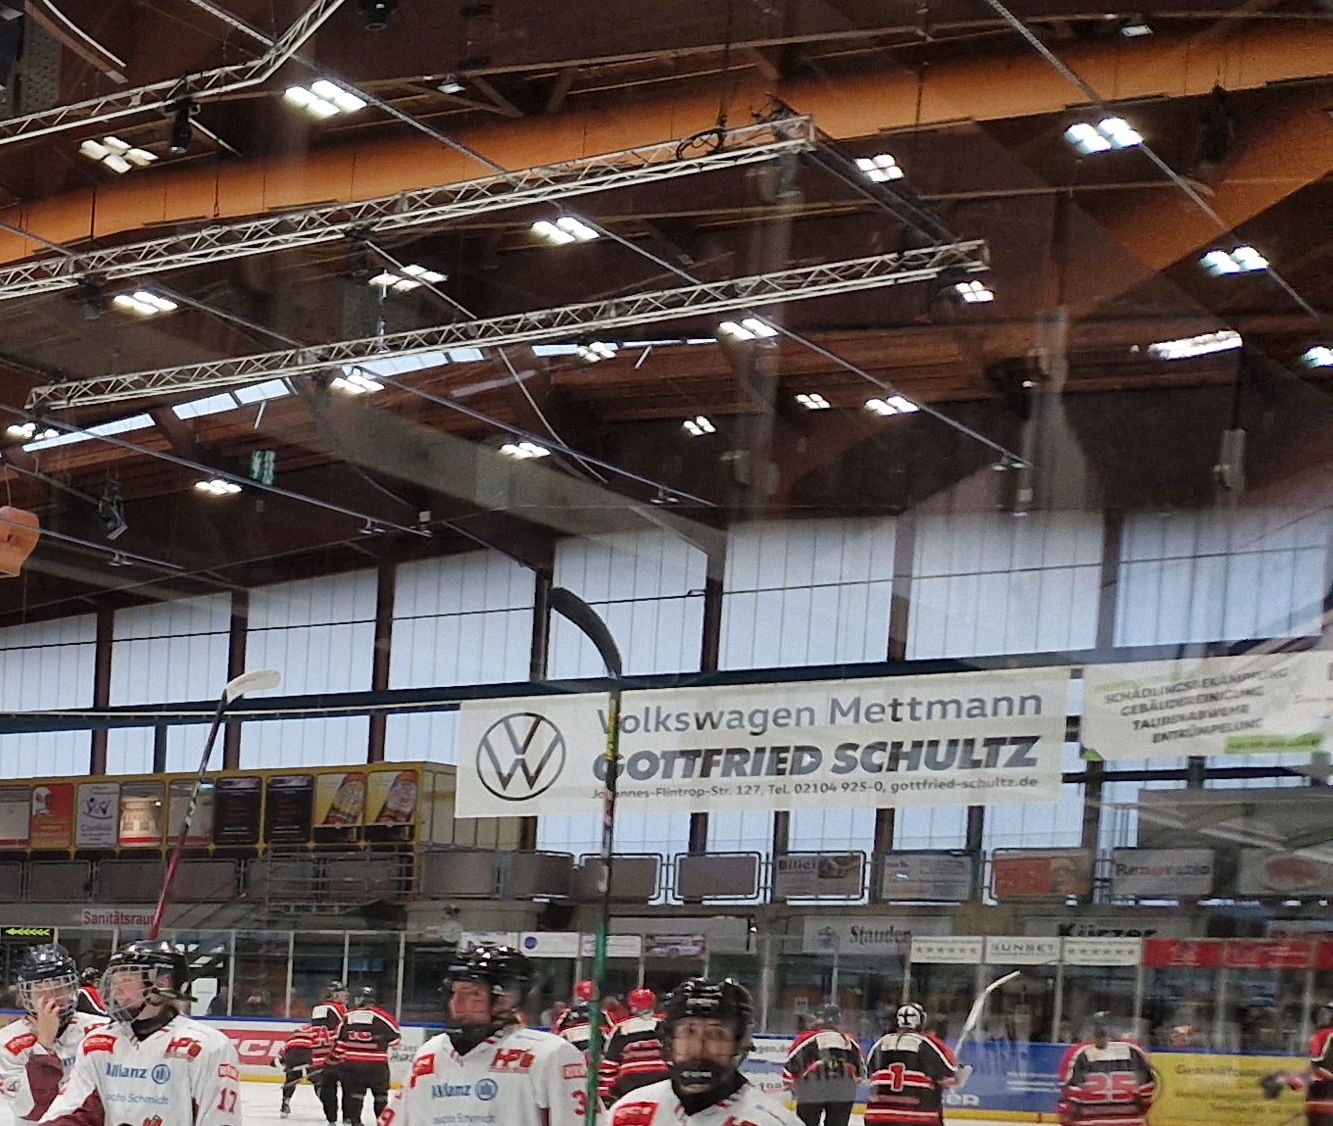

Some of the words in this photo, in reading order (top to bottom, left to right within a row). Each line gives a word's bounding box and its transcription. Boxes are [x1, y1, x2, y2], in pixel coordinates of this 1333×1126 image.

[597, 701, 815, 736] Volkswagen
[829, 694, 1043, 726] Mettmann
[593, 745, 822, 781] GOTTFRIED
[833, 735, 1041, 774] SCHULTZ
[769, 783, 790, 795] Tel.
[794, 782, 837, 794] 02104
[841, 780, 886, 794] 925-0,
[891, 775, 1039, 793] gottfried-schultz.de
[890, 1063, 906, 1091] 1
[1083, 1074, 1136, 1101] 25
[217, 1088, 238, 1113] 17
